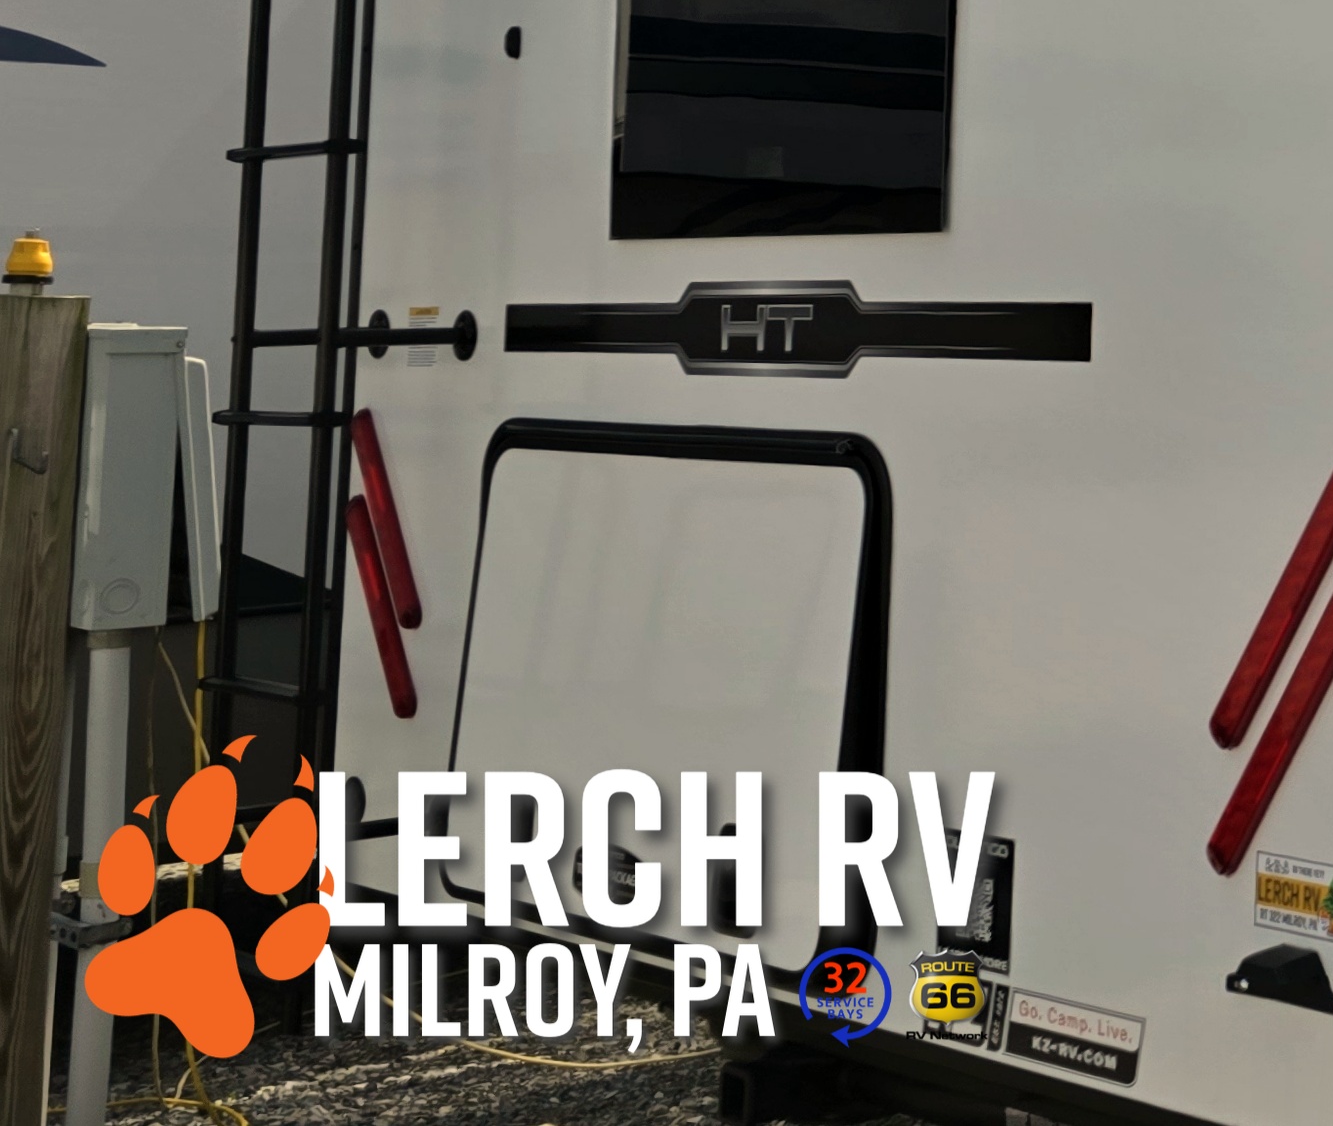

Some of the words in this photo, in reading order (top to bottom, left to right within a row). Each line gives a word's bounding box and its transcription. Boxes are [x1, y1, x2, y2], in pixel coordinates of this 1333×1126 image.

[720, 303, 814, 353] HT
[1258, 875, 1300, 908] LERCH
[1303, 885, 1322, 912] RV
[1018, 999, 1043, 1022] Go.
[1046, 1007, 1093, 1038] Camp.
[1097, 1019, 1134, 1045] Live.
[1030, 1035, 1119, 1072] KZ-RV.COM
